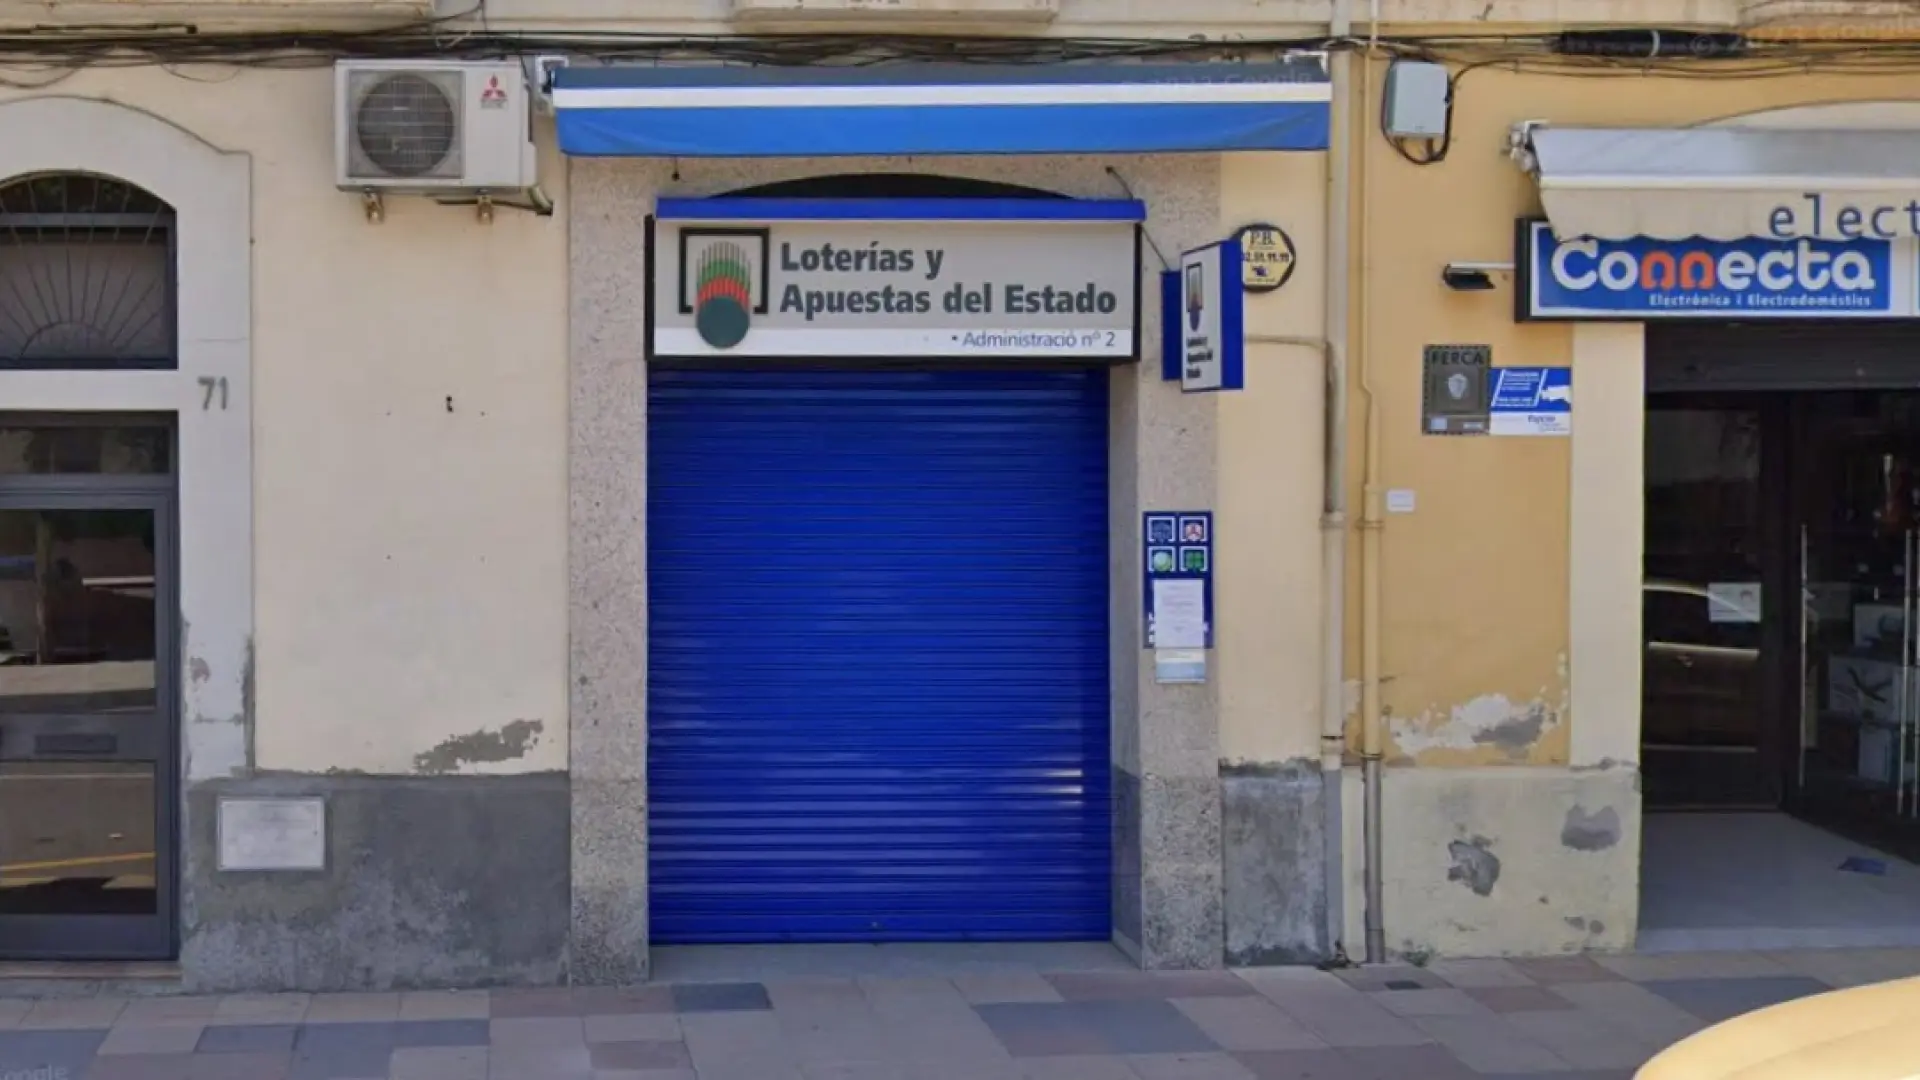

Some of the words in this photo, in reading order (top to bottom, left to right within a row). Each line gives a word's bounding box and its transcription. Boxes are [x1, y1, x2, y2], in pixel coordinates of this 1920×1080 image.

[780, 241, 914, 271] Loterías
[925, 249, 944, 280] y
[1551, 239, 1876, 291] Connecta
[780, 284, 931, 321] Apuestas
[943, 282, 992, 314] del
[1004, 282, 1117, 314] Estado
[961, 331, 1077, 348] Administració
[1105, 332, 1116, 347] 2
[197, 376, 228, 411] 71
